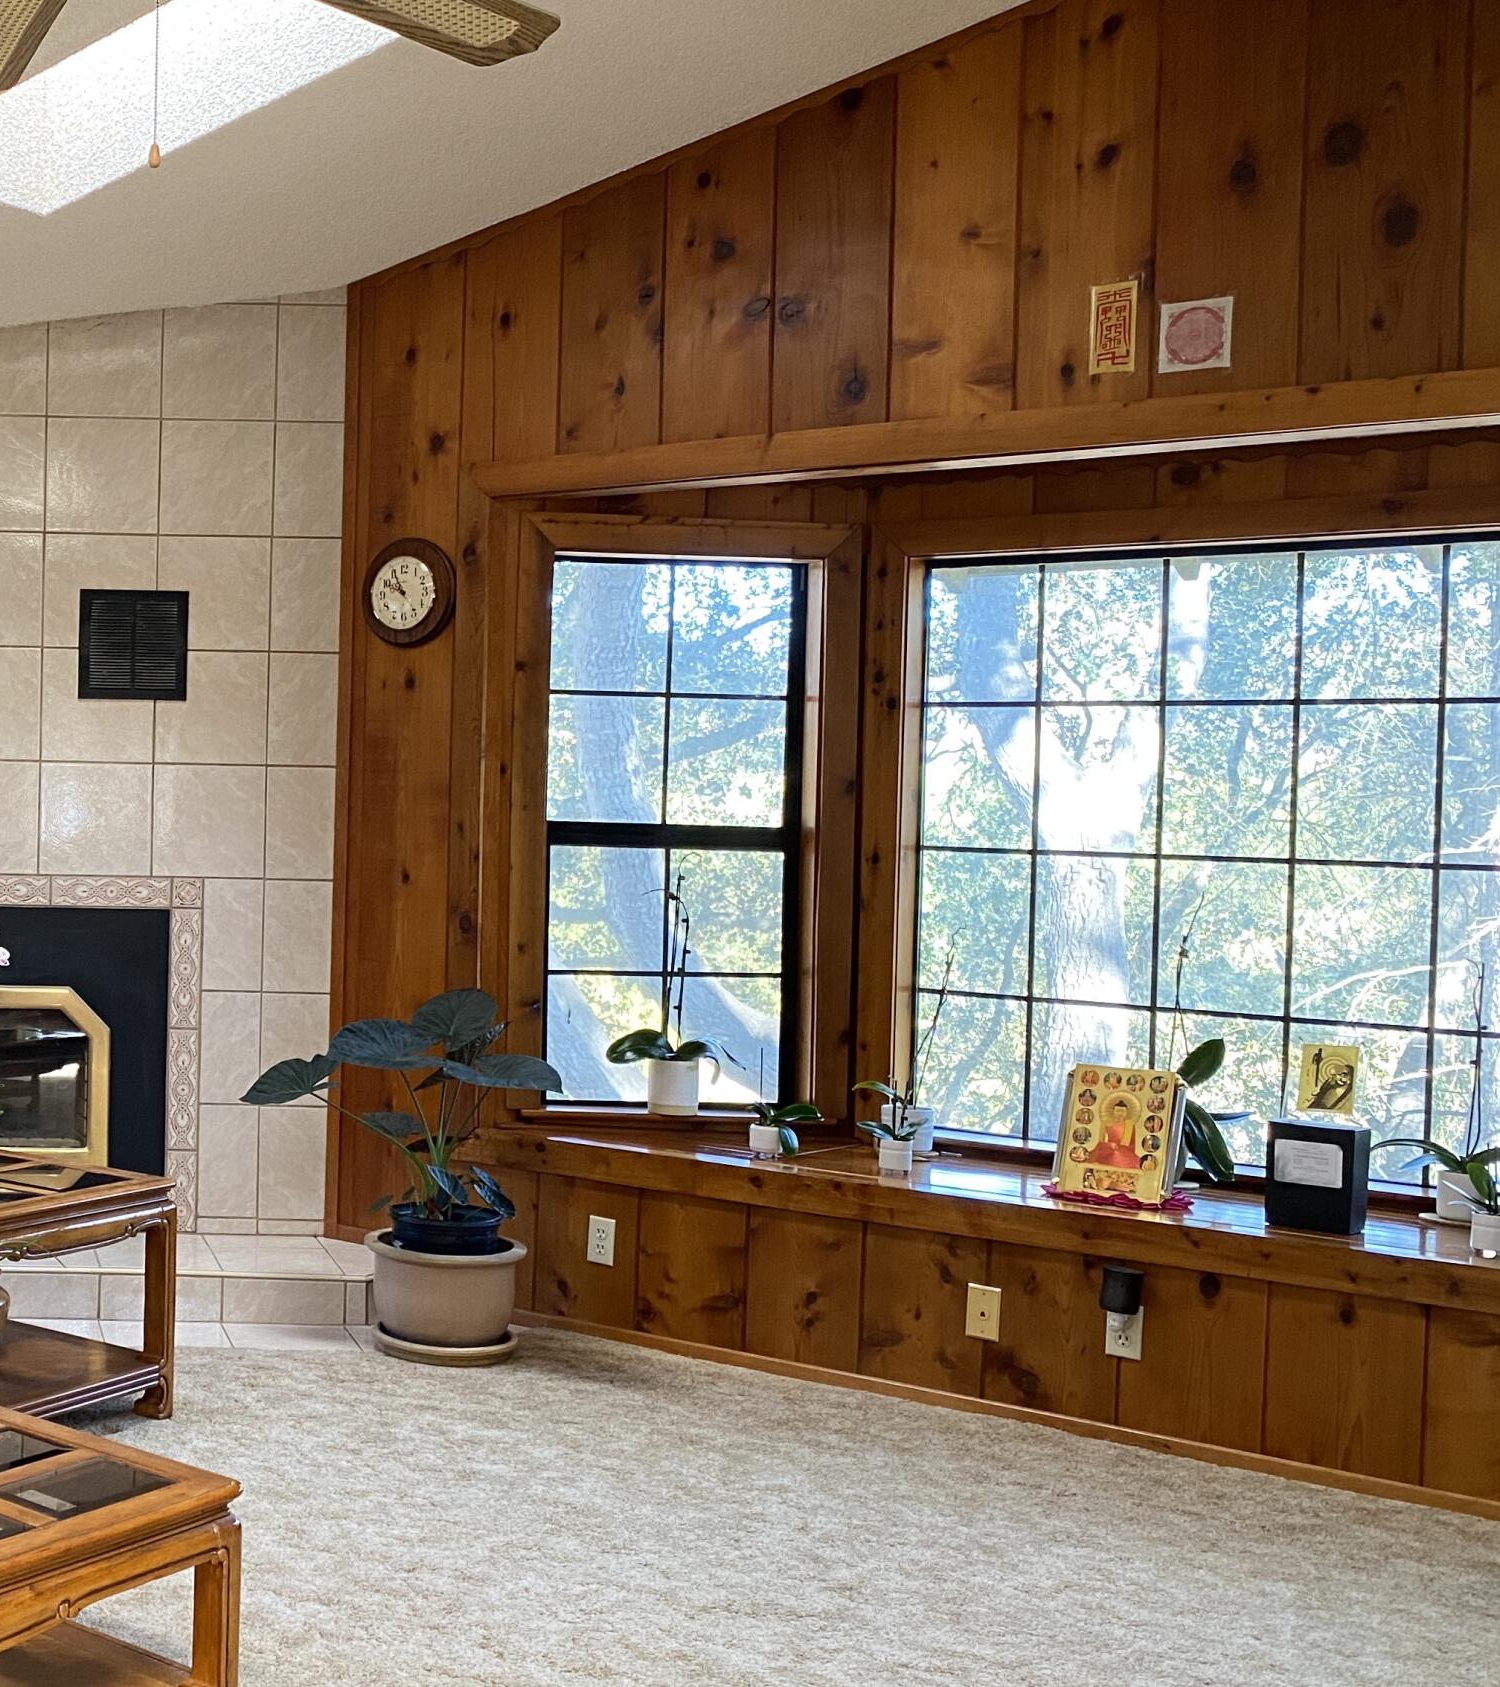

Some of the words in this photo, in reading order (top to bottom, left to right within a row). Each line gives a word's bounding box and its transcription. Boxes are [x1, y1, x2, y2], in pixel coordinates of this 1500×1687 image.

[401, 564, 409, 575] 12
[420, 575, 426, 585] 2
[379, 590, 386, 600] 9
[422, 586, 428, 597] 3
[400, 612, 408, 622] 6
